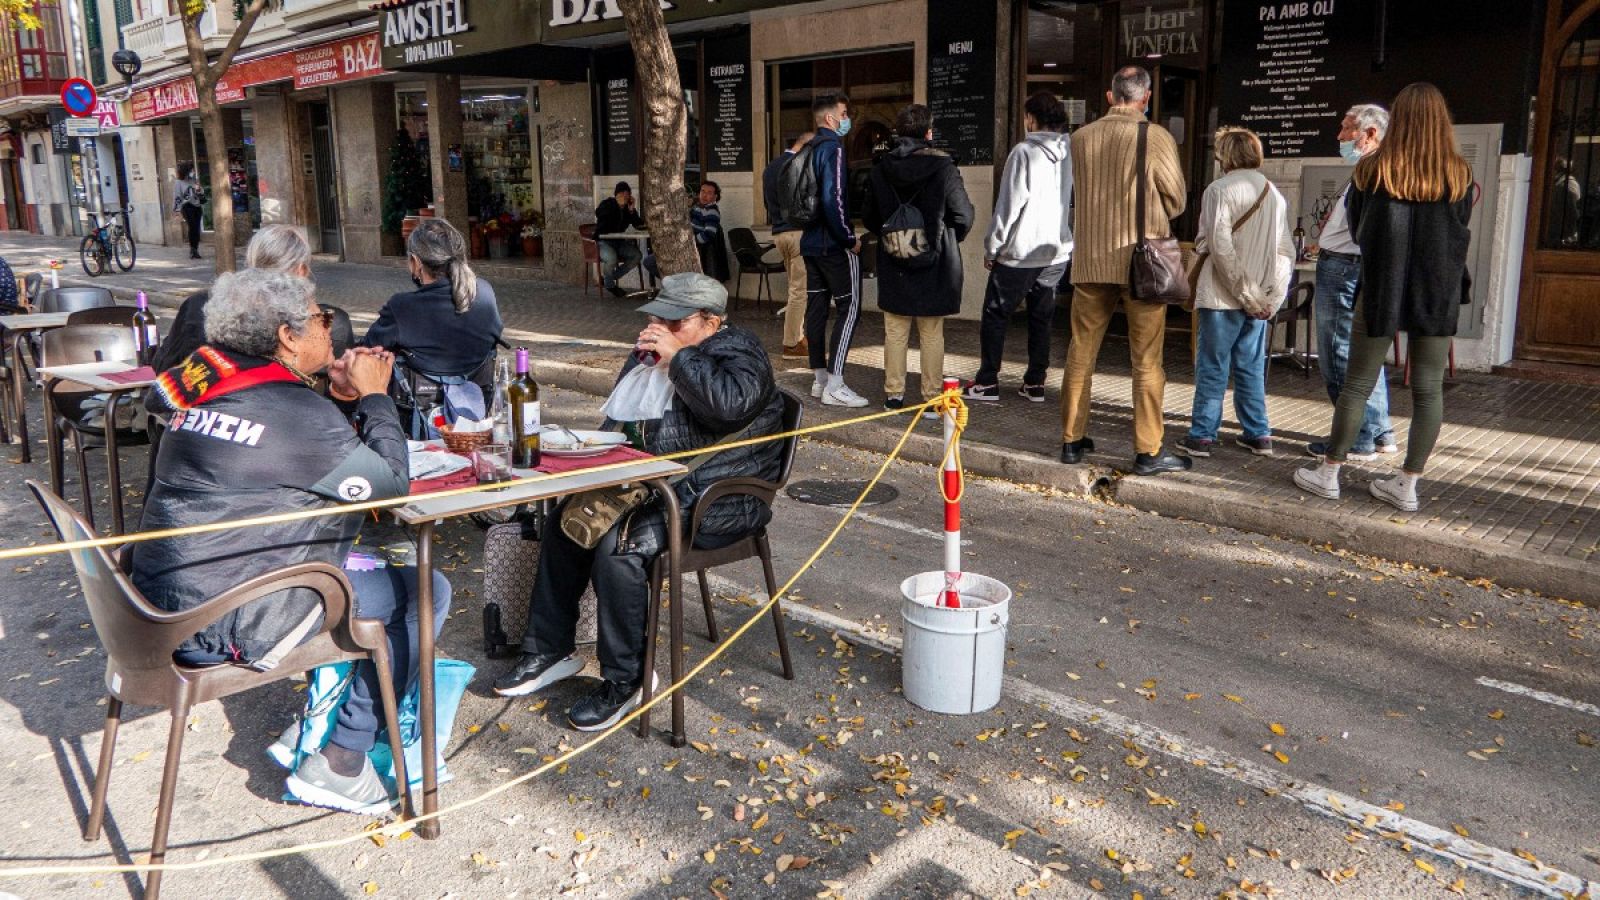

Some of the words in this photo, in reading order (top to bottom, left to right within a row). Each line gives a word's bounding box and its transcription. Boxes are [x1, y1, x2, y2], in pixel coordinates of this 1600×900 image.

[1144, 6, 1195, 31] bar
[1260, 6, 1276, 21] PA
[1280, 2, 1309, 20] AMB
[1312, 0, 1334, 15] OLI
[384, 0, 468, 47] AMSTEL
[949, 41, 972, 55] MENU
[1124, 18, 1200, 57] VENECIA
[343, 40, 382, 74] BAZ
[405, 46, 425, 63] 100%
[427, 40, 453, 59] MALTA
